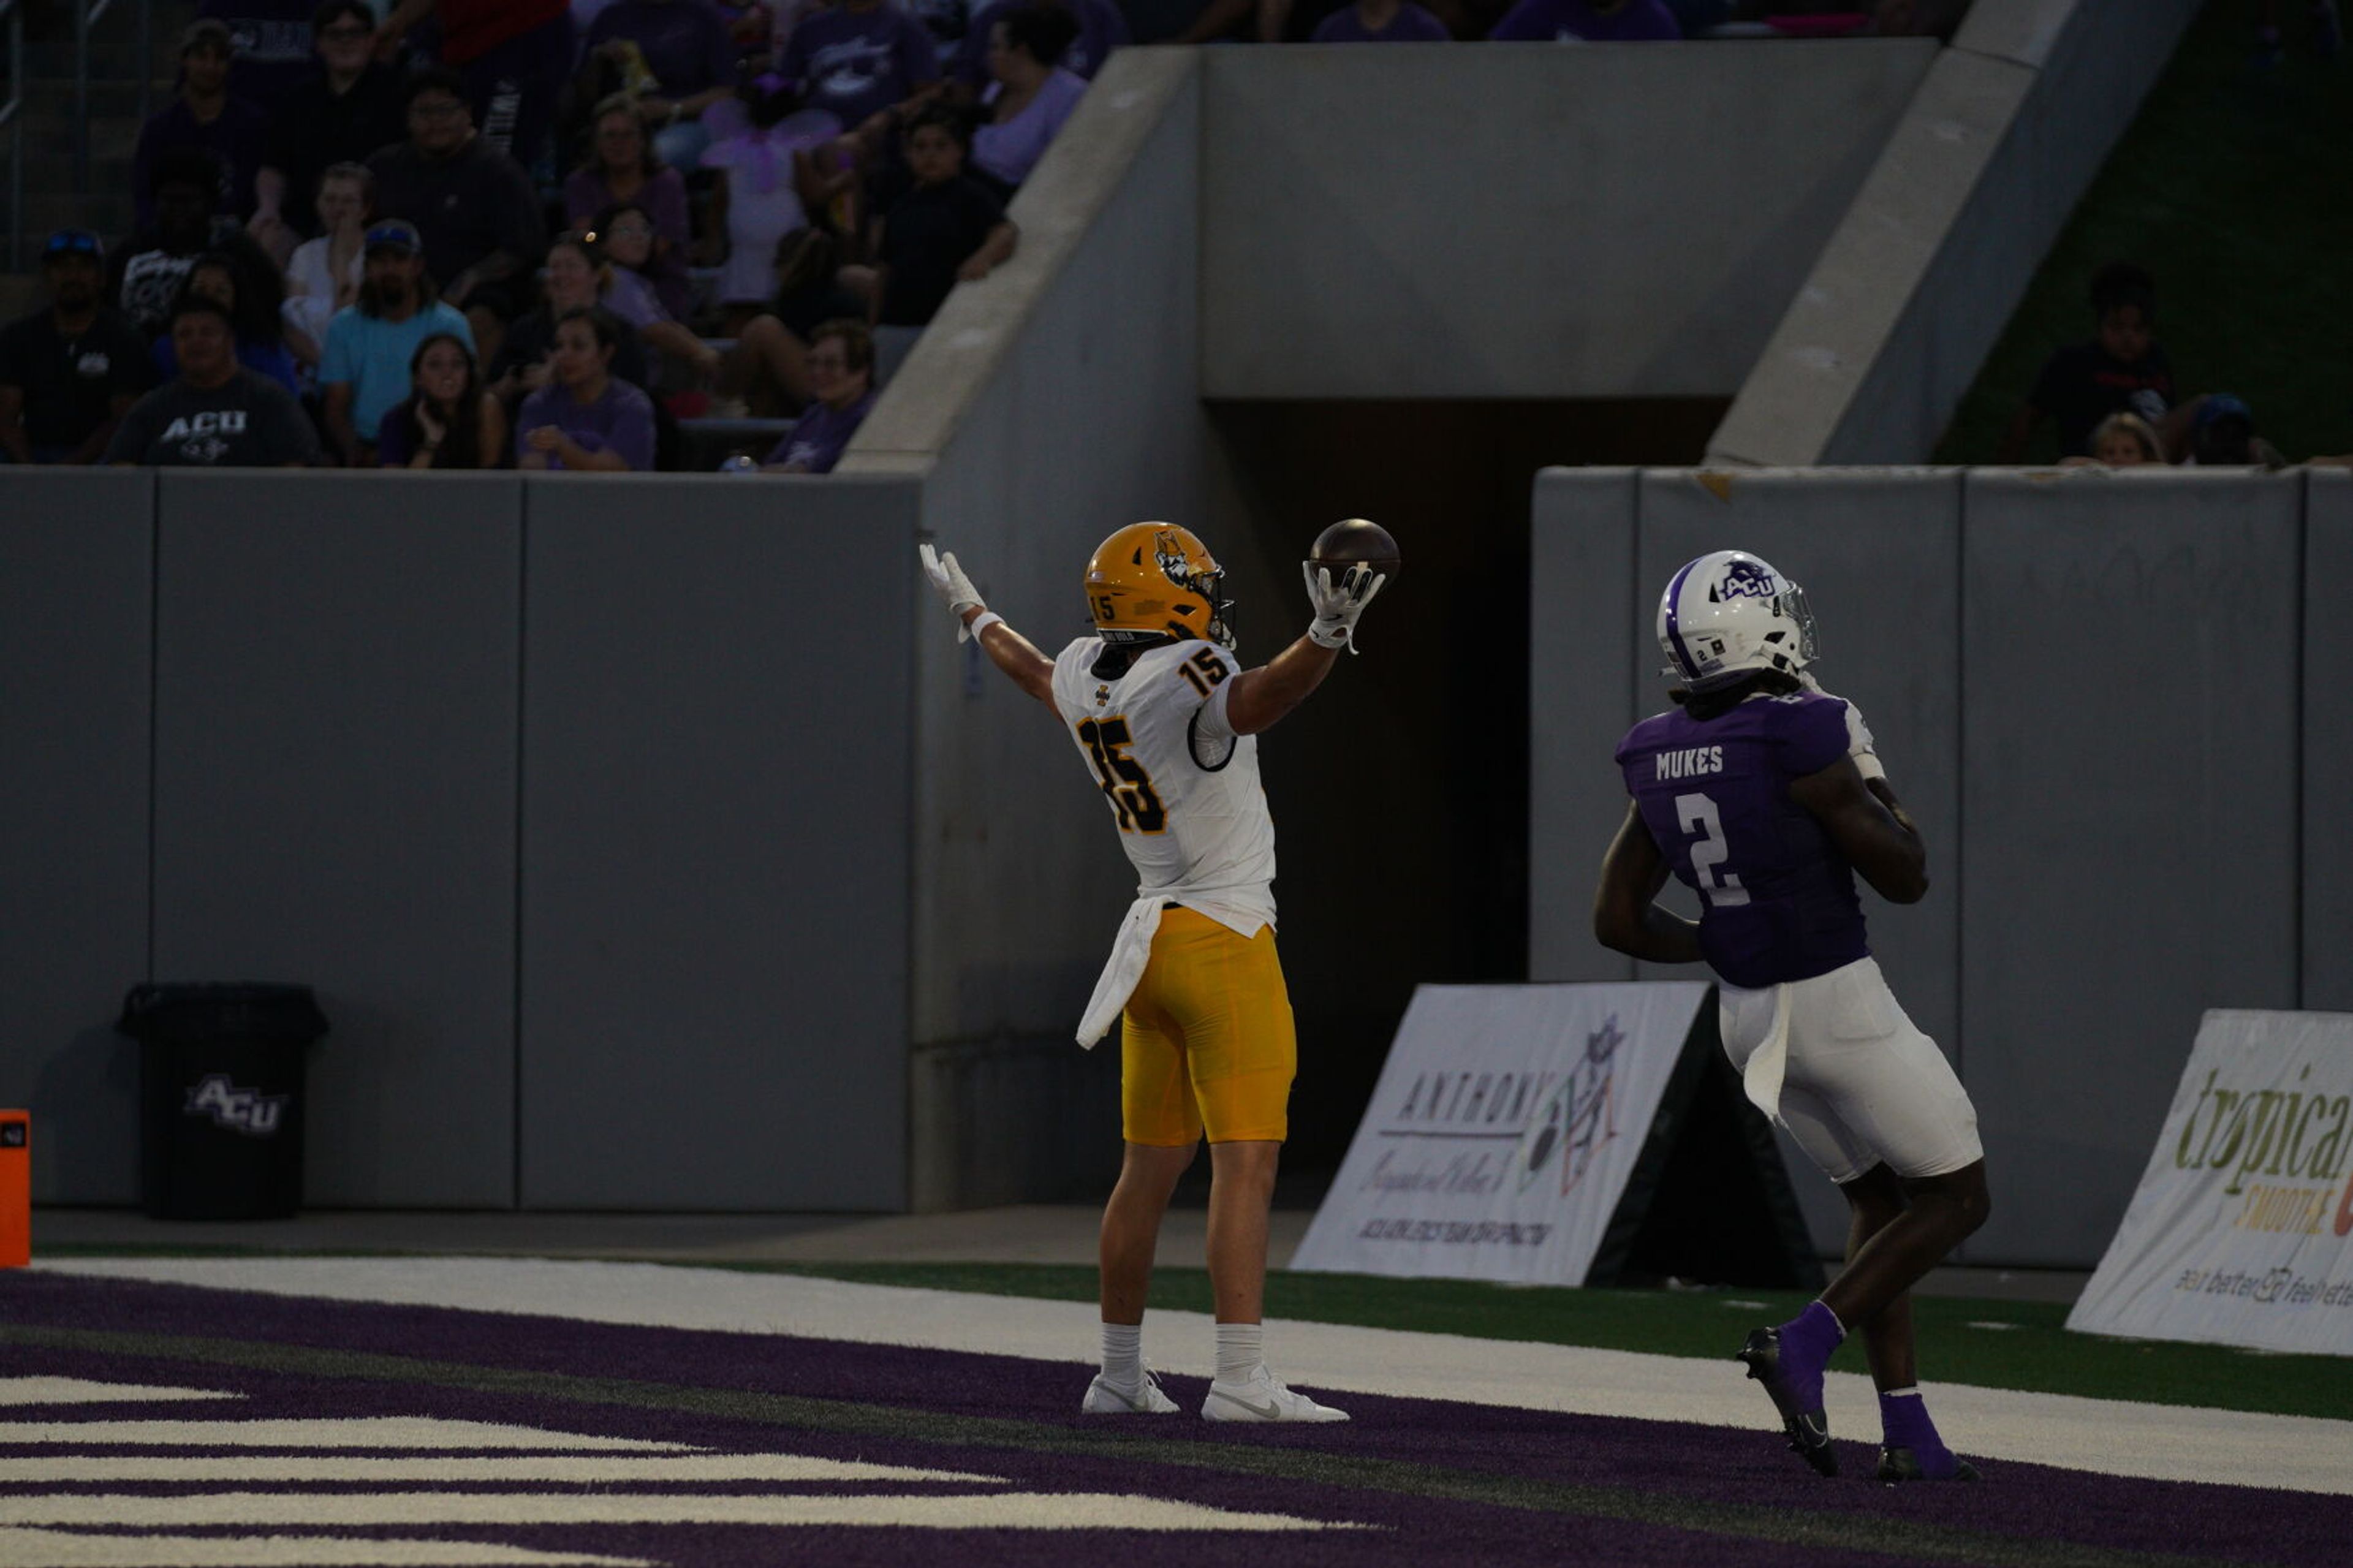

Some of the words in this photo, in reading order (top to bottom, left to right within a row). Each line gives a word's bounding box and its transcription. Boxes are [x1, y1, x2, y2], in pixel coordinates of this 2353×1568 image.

[159, 410, 247, 443] ACU
[1091, 596, 1115, 620] 15
[1722, 575, 1775, 599] ACU
[1179, 646, 1230, 698] 15
[1077, 716, 1167, 835] 15
[1656, 746, 1723, 781] MUKES
[1675, 792, 1751, 907] 2
[189, 1075, 284, 1132] ACU
